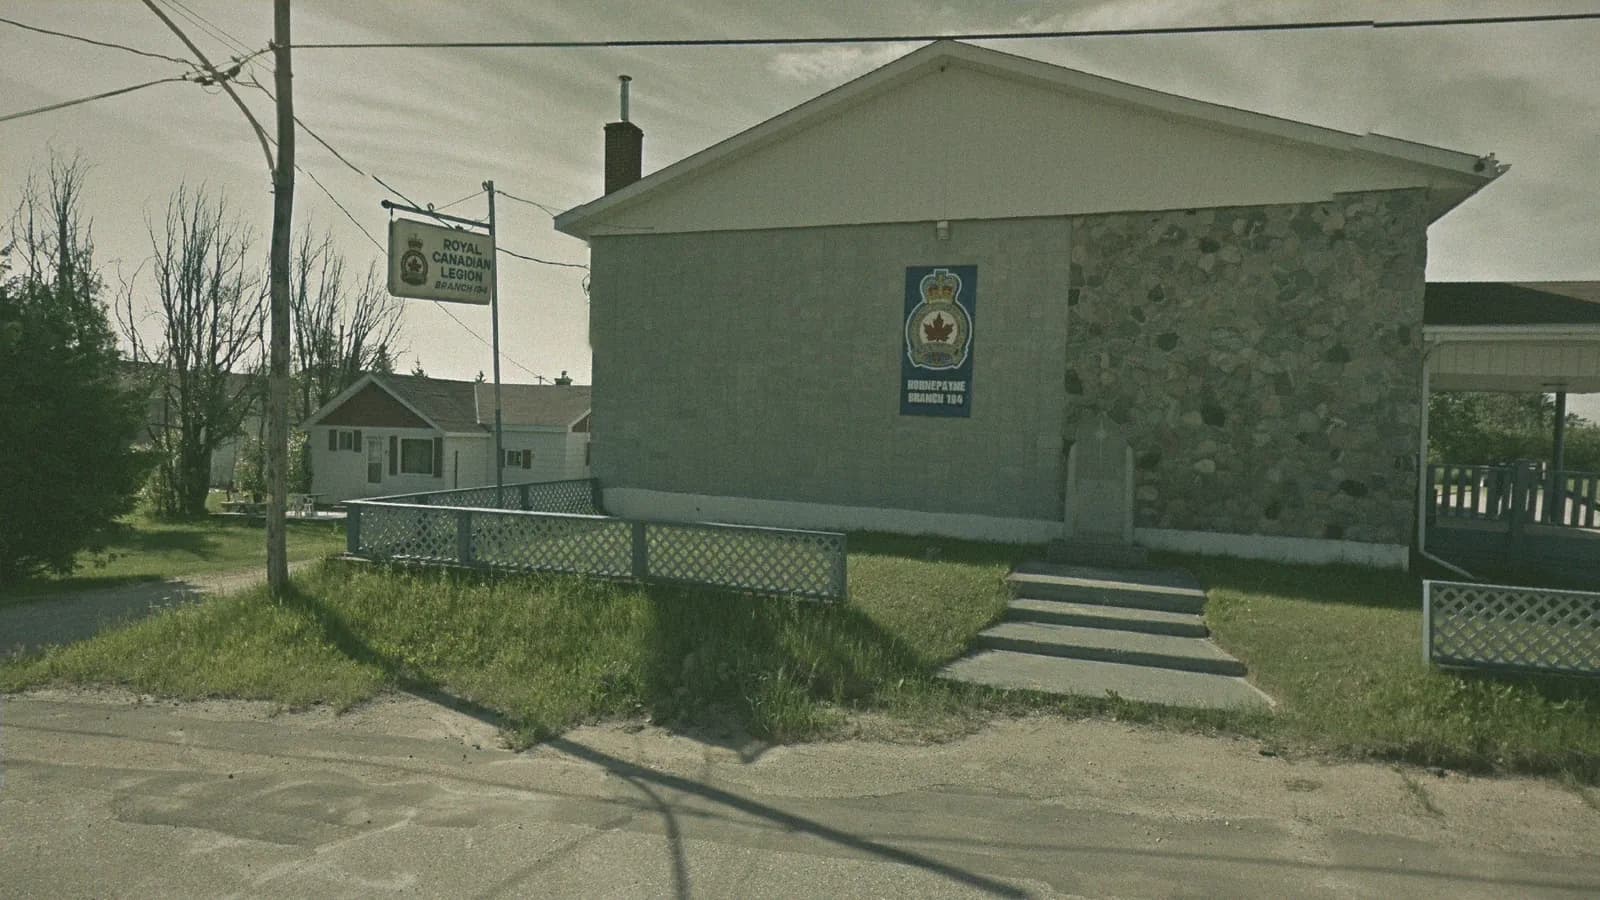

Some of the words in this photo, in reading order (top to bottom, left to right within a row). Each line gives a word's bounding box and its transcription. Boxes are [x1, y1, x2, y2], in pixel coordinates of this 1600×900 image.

[443, 239, 482, 255] ROYAL
[432, 251, 491, 270] CANADIAN
[440, 266, 483, 282] LEGION
[434, 281, 473, 292] BRANCH
[908, 392, 944, 404] BRANCH
